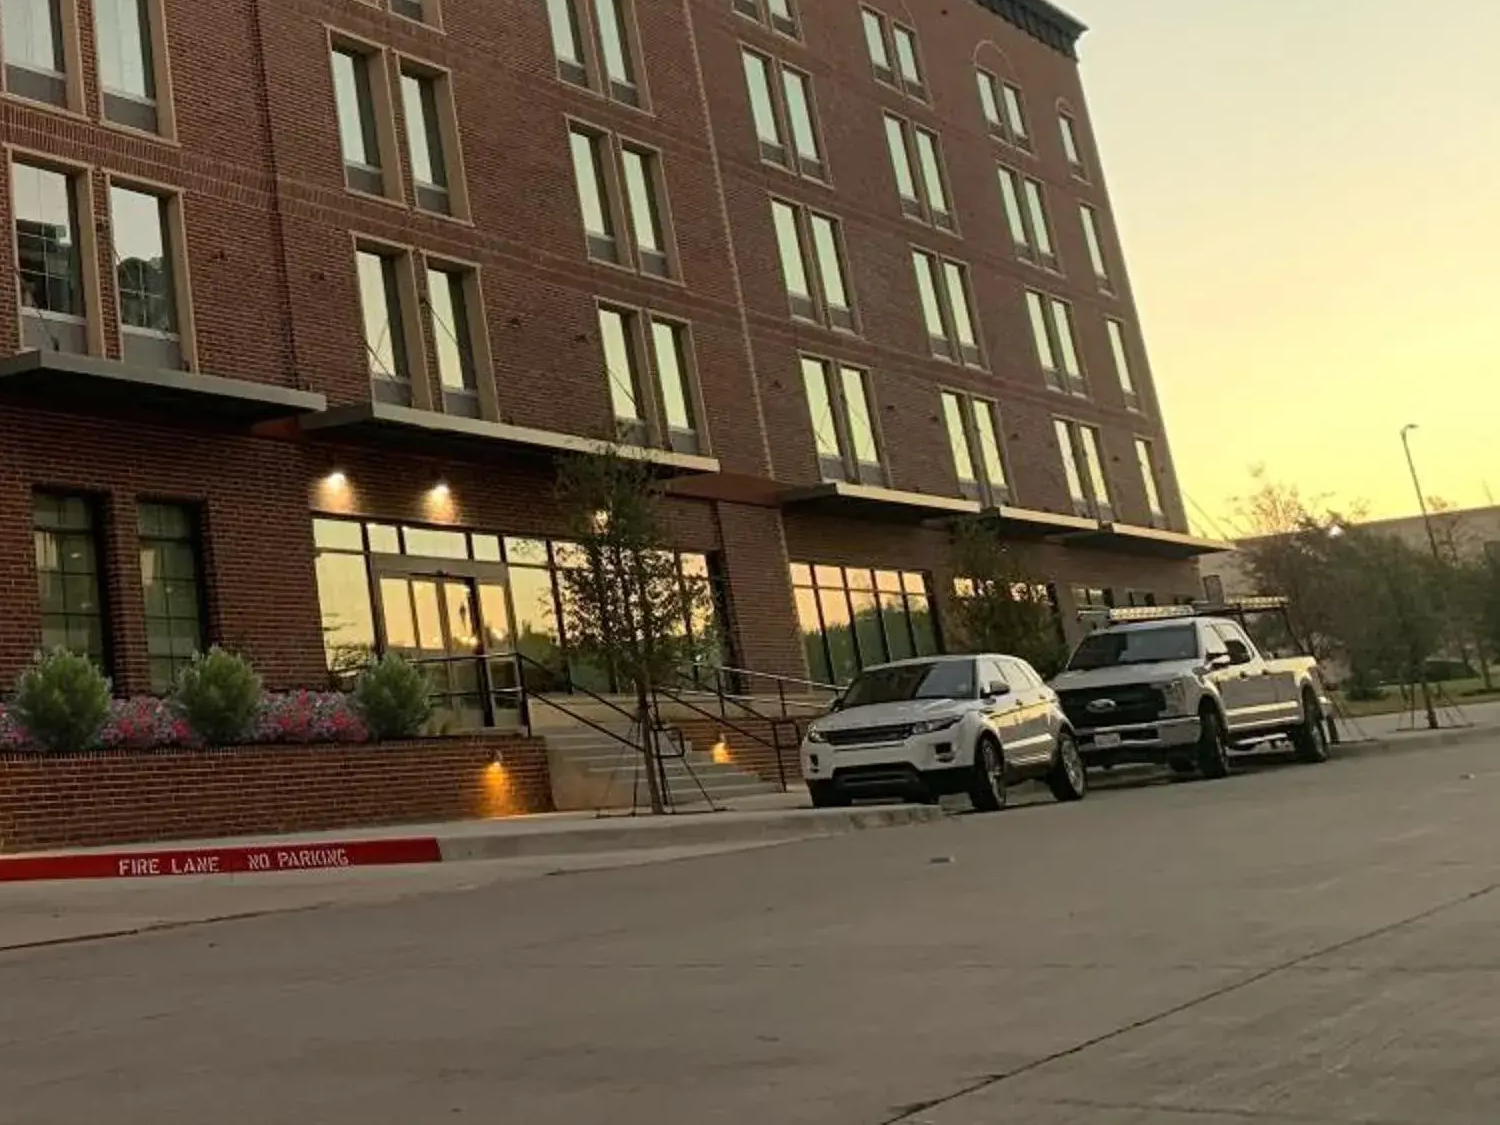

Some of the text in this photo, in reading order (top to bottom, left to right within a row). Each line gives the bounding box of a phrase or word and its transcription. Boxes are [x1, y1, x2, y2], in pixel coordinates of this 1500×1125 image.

[118, 848, 349, 875] FIRE LANE NO PARKING
